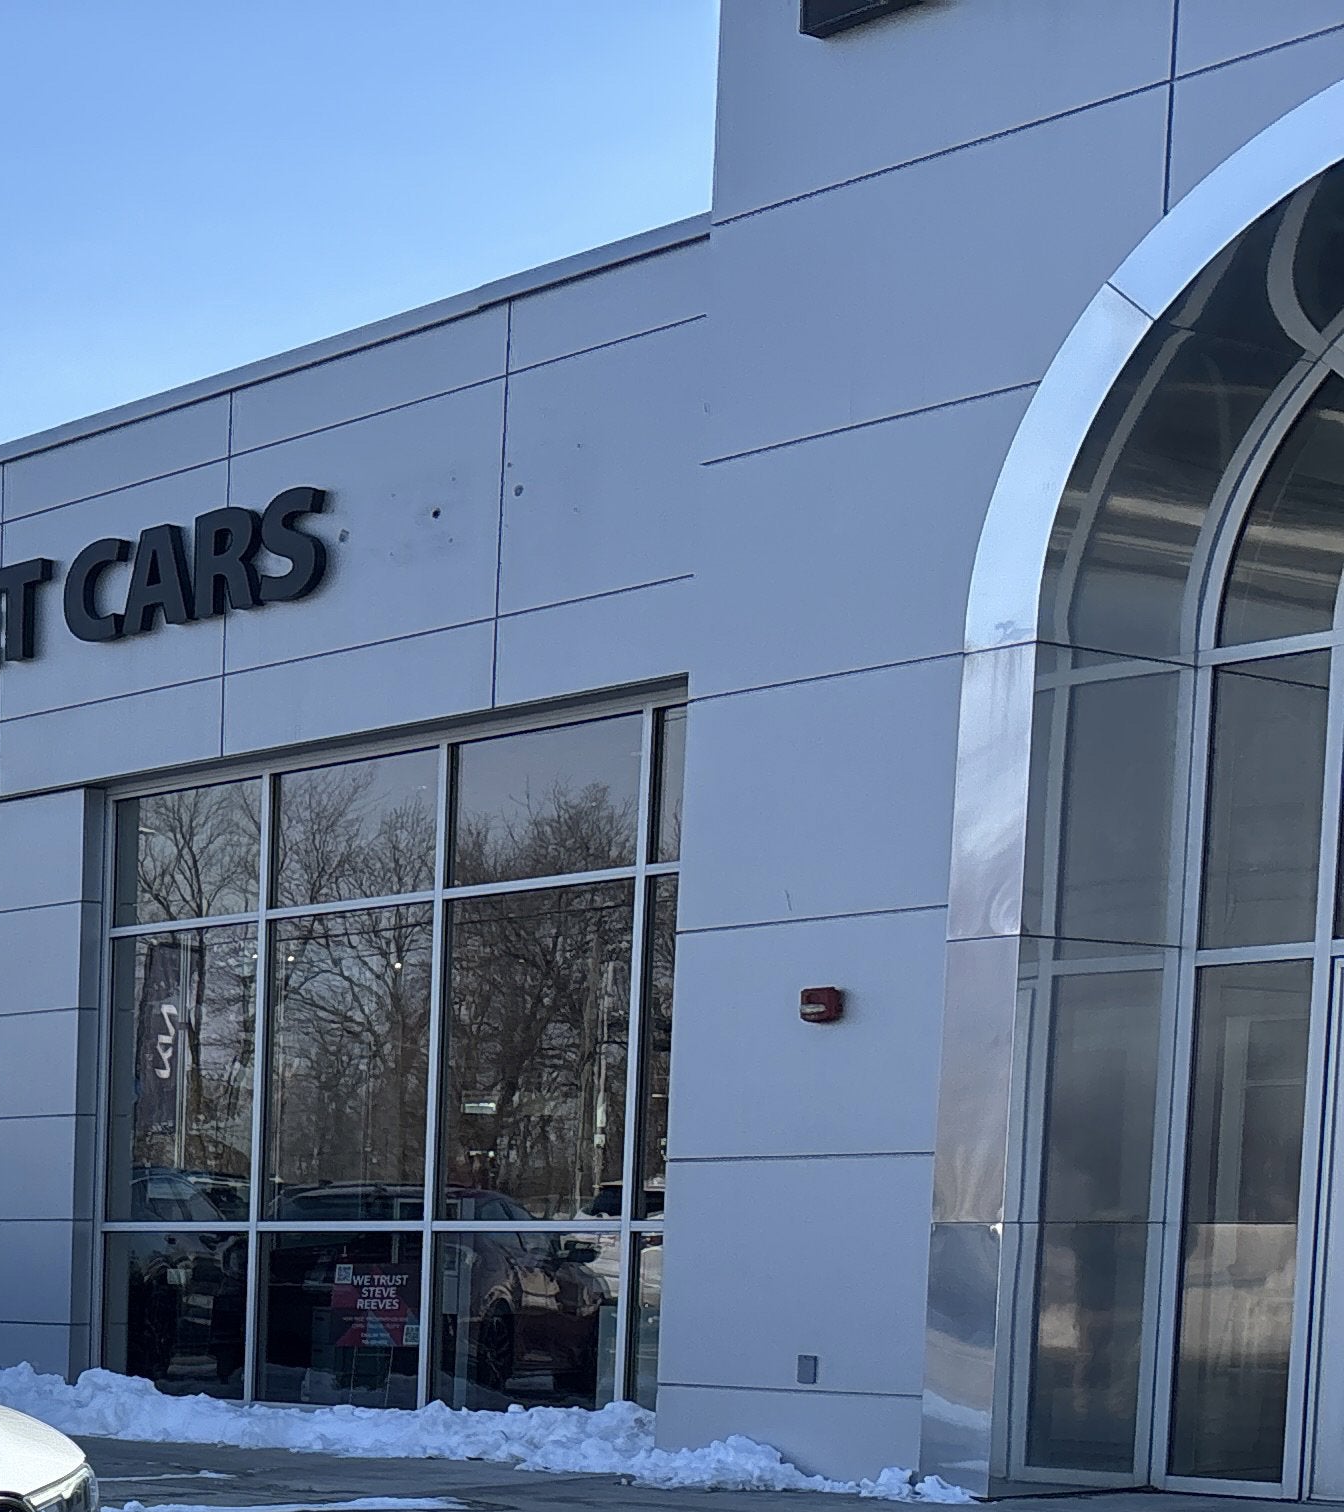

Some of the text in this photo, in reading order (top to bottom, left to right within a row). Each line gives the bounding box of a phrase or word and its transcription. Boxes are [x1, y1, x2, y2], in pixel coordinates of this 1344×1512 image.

[64, 486, 328, 643] CARS
[353, 1274, 409, 1286] WE TRUST
[361, 1286, 397, 1298] STEVE
[356, 1298, 400, 1310] REEVES
